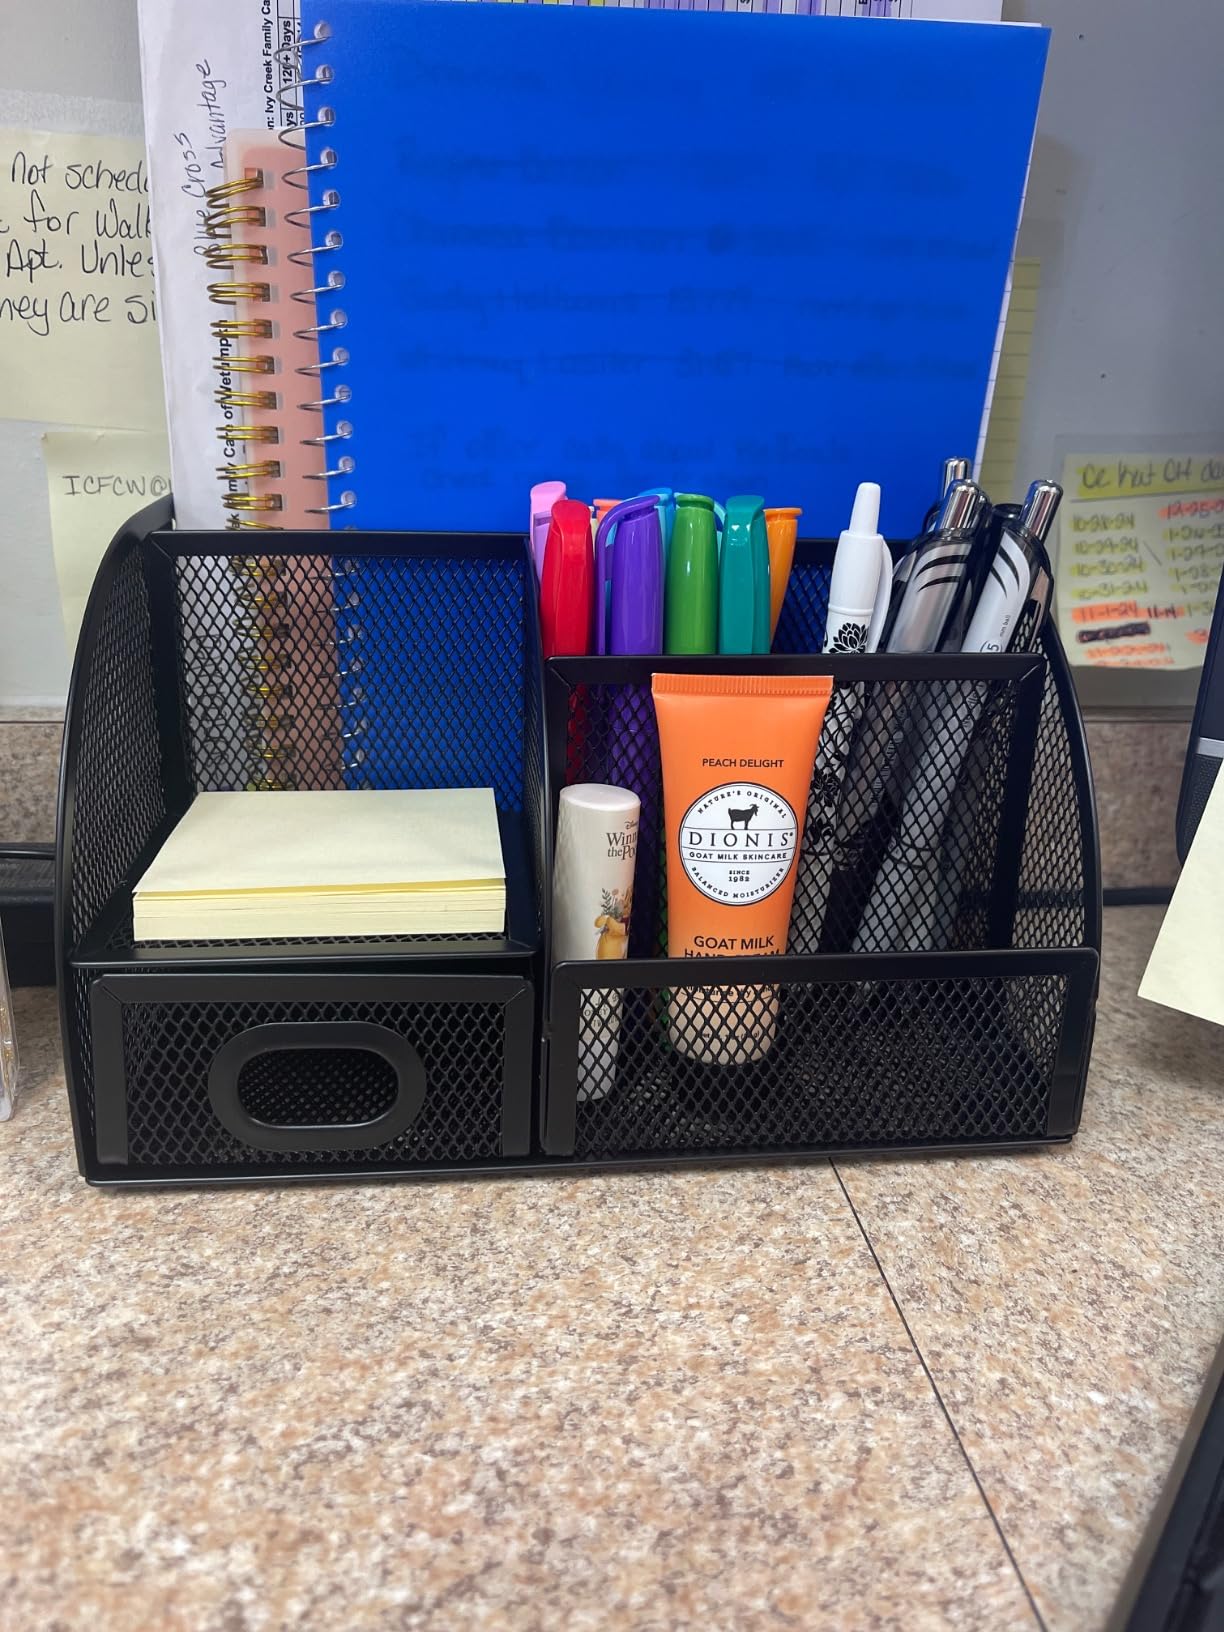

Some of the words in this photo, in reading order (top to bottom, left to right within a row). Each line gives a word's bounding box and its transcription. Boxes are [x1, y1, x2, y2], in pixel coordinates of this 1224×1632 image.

[261, 18, 274, 57] Family
[282, 20, 294, 52] Days
[262, 60, 274, 93] Creek
[264, 97, 276, 114] Ivy
[172, 131, 206, 198] Cross
[24, 189, 79, 234] for
[6, 238, 63, 283] Apt.
[60, 291, 112, 322] are
[220, 403, 233, 420] of
[702, 758, 737, 768] PEACH
[739, 758, 784, 769] DELIGHT
[697, 789, 741, 815] NATURE'S
[746, 790, 787, 819] ORIGINAL
[689, 850, 714, 860] GOAT
[717, 853, 739, 861] MILK
[742, 852, 787, 861] SKINCARE
[691, 866, 729, 898] BALANCED
[733, 867, 784, 899] MOISTURIZER
[728, 875, 750, 883] 1982
[693, 935, 737, 950] GOAT
[740, 935, 775, 950] MILK
